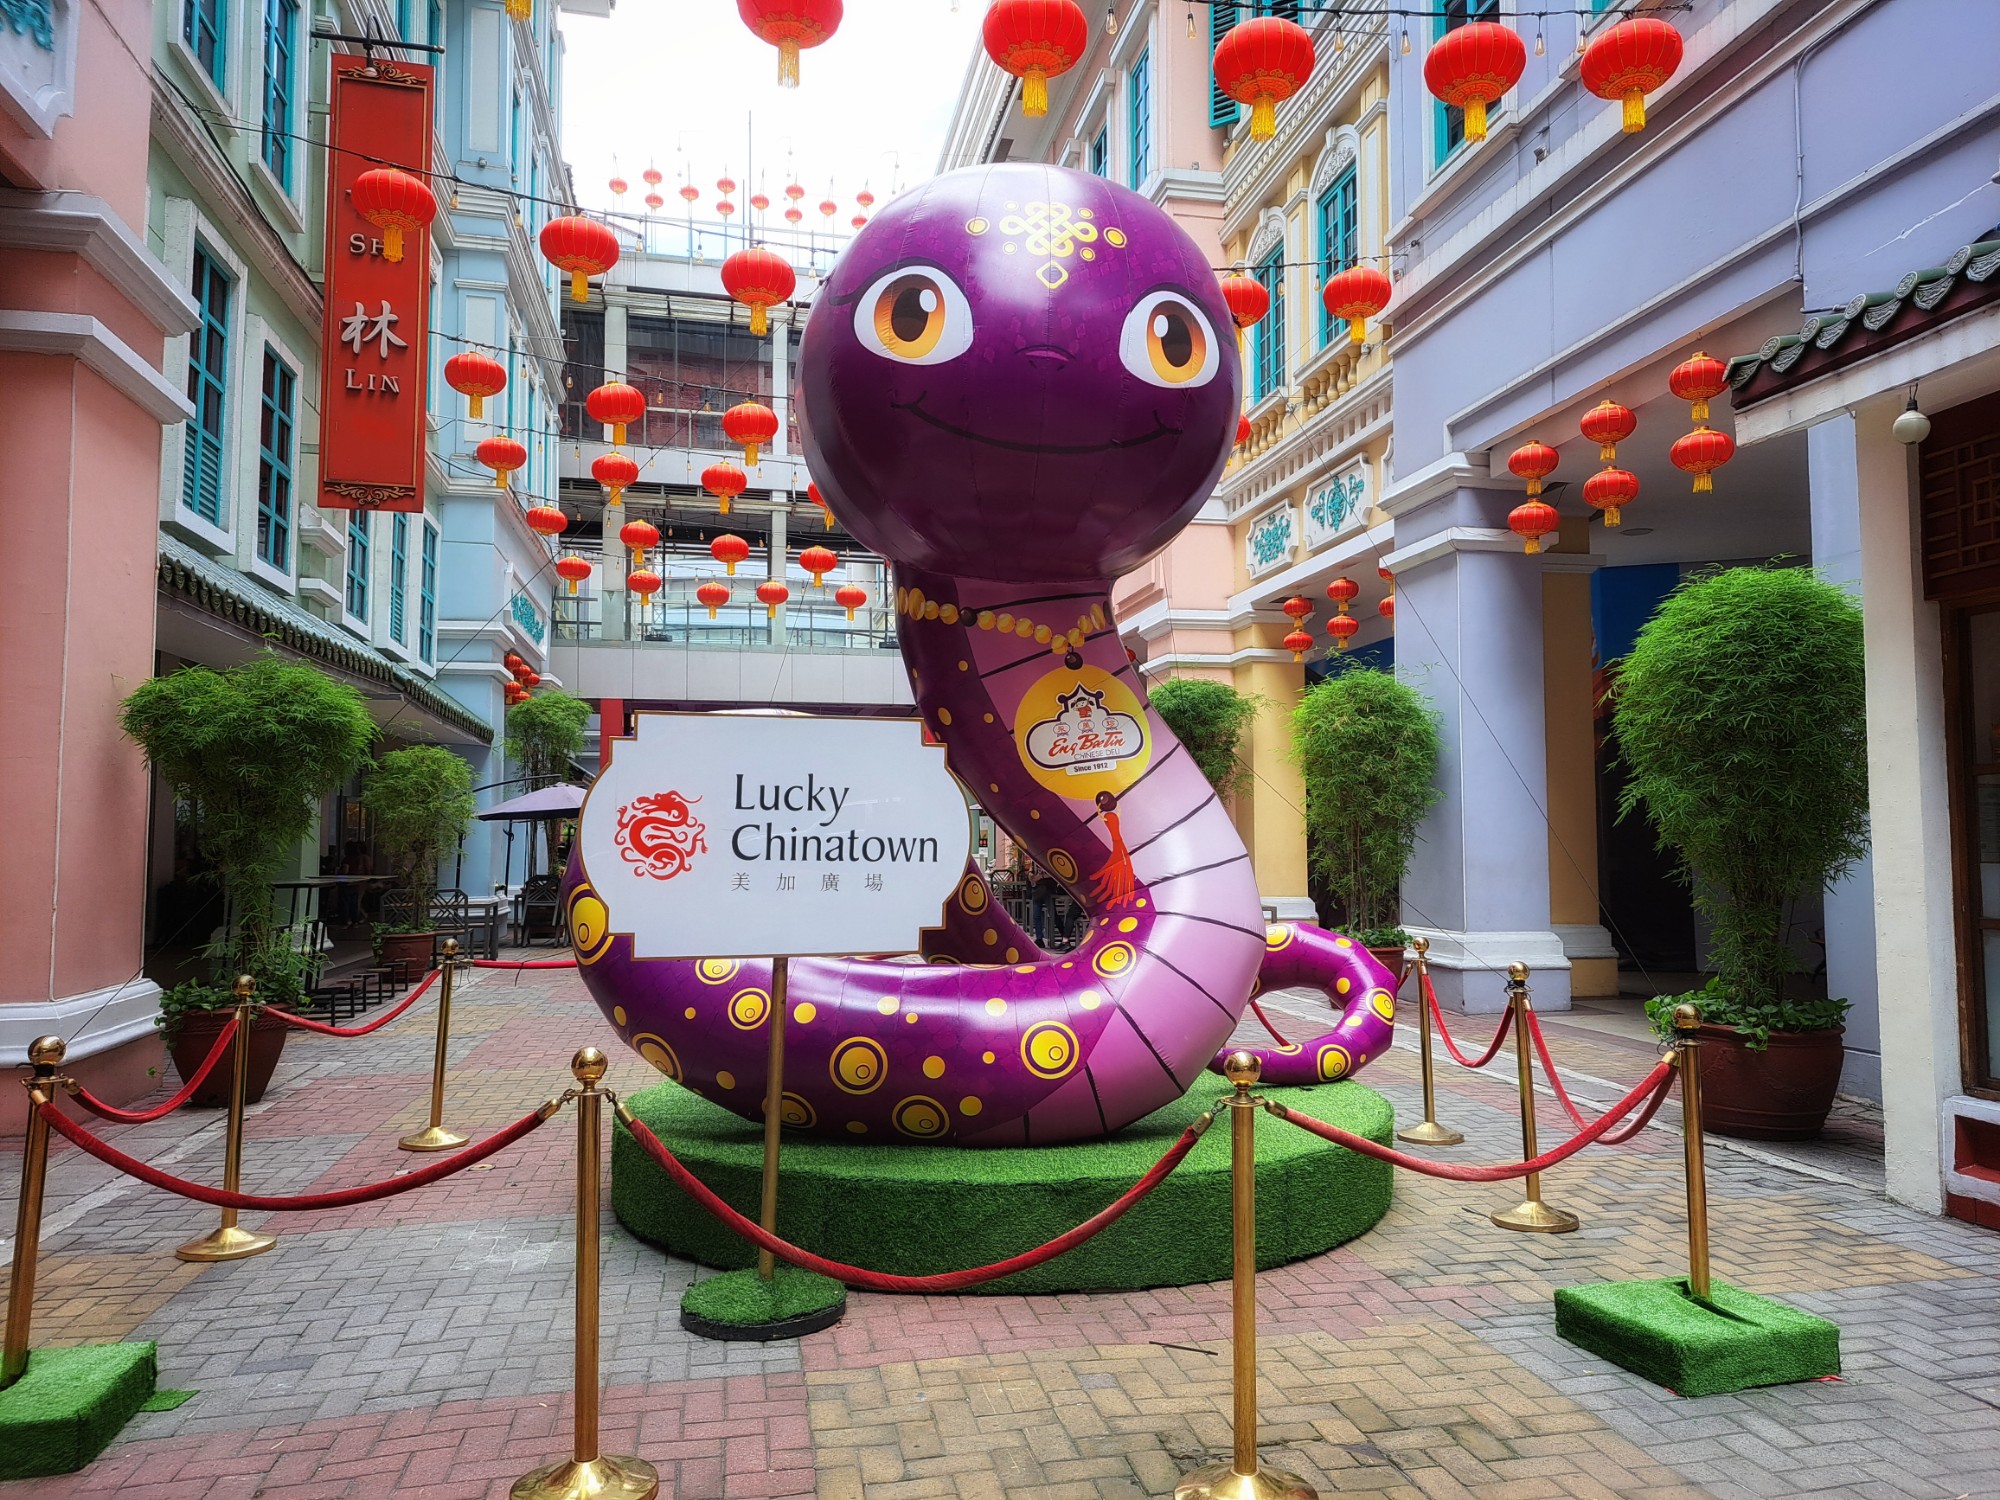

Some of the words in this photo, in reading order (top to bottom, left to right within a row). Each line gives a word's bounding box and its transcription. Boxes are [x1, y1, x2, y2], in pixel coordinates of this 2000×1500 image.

[350, 233, 404, 258] SH
[341, 300, 408, 359] 林
[345, 369, 399, 392] LIN
[1048, 737, 1078, 757] Eng
[1103, 731, 1125, 748] Tin
[1073, 750, 1103, 760] CHINESE
[1073, 764, 1092, 772] Since
[1093, 762, 1108, 770] 1912
[735, 773, 849, 826] Lucky
[731, 822, 938, 862] Chinatown
[731, 872, 884, 892] 美加廣場
